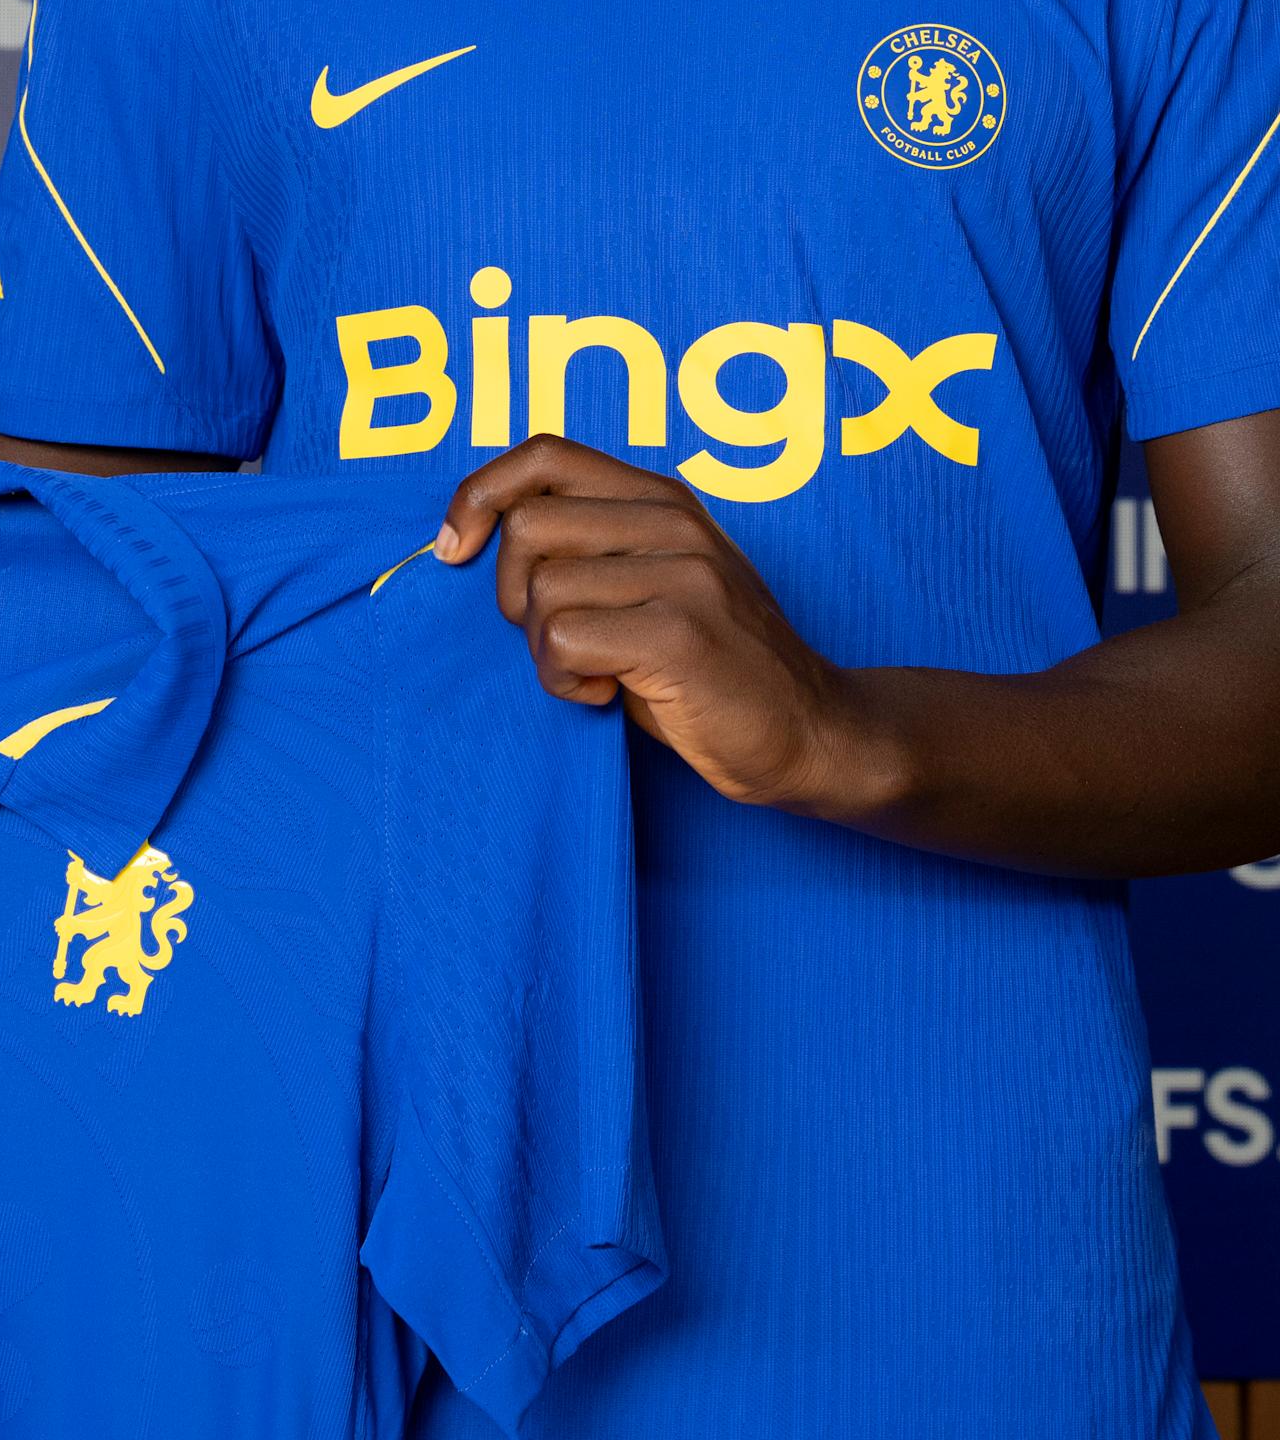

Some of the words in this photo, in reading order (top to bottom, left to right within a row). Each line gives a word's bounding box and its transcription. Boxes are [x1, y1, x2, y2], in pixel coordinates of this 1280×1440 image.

[890, 29, 982, 65] CHELSEA
[880, 126, 943, 162] FOOTBALL
[946, 140, 977, 161] CLUB
[335, 265, 998, 504] Bingx
